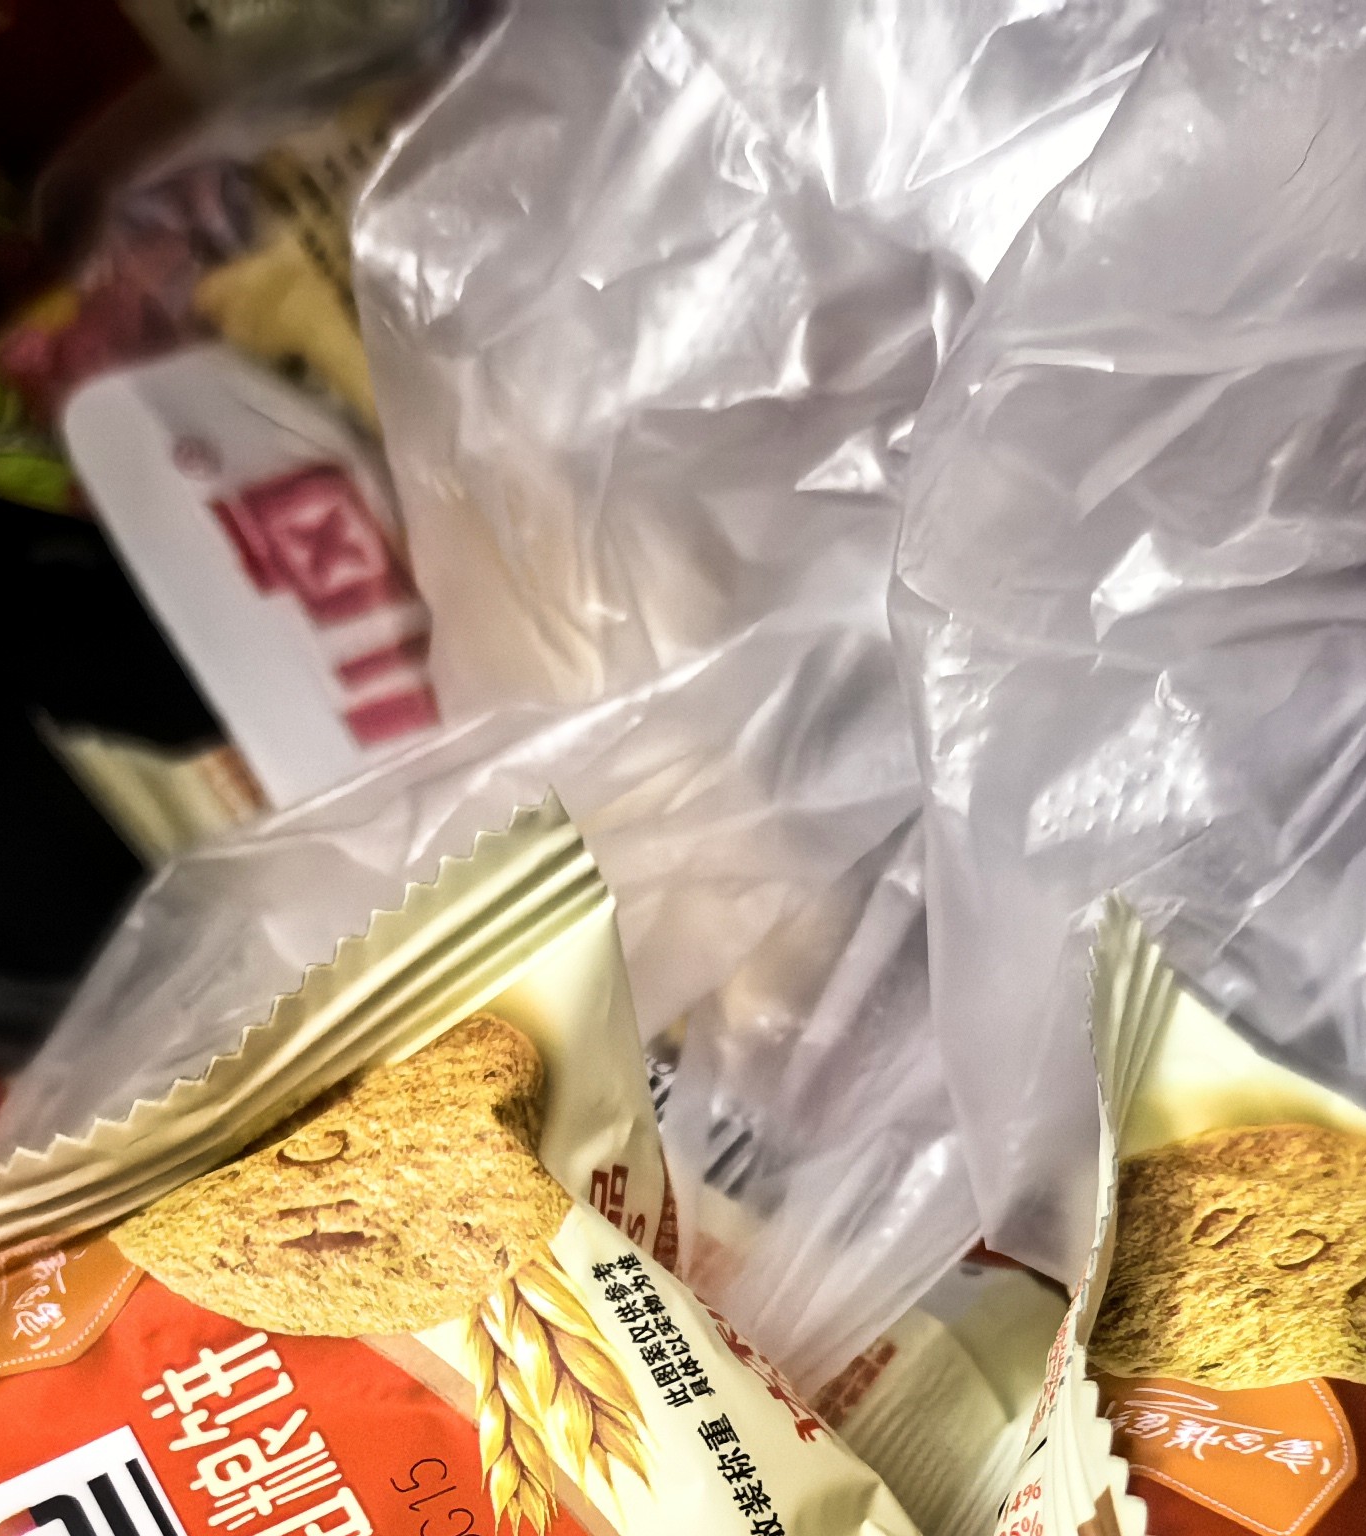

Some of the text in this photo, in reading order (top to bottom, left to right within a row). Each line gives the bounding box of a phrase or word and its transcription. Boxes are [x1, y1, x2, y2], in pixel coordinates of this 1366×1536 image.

[593, 1260, 695, 1408] 此图案仅供参考
[616, 1252, 716, 1398] 具体以实物为准
